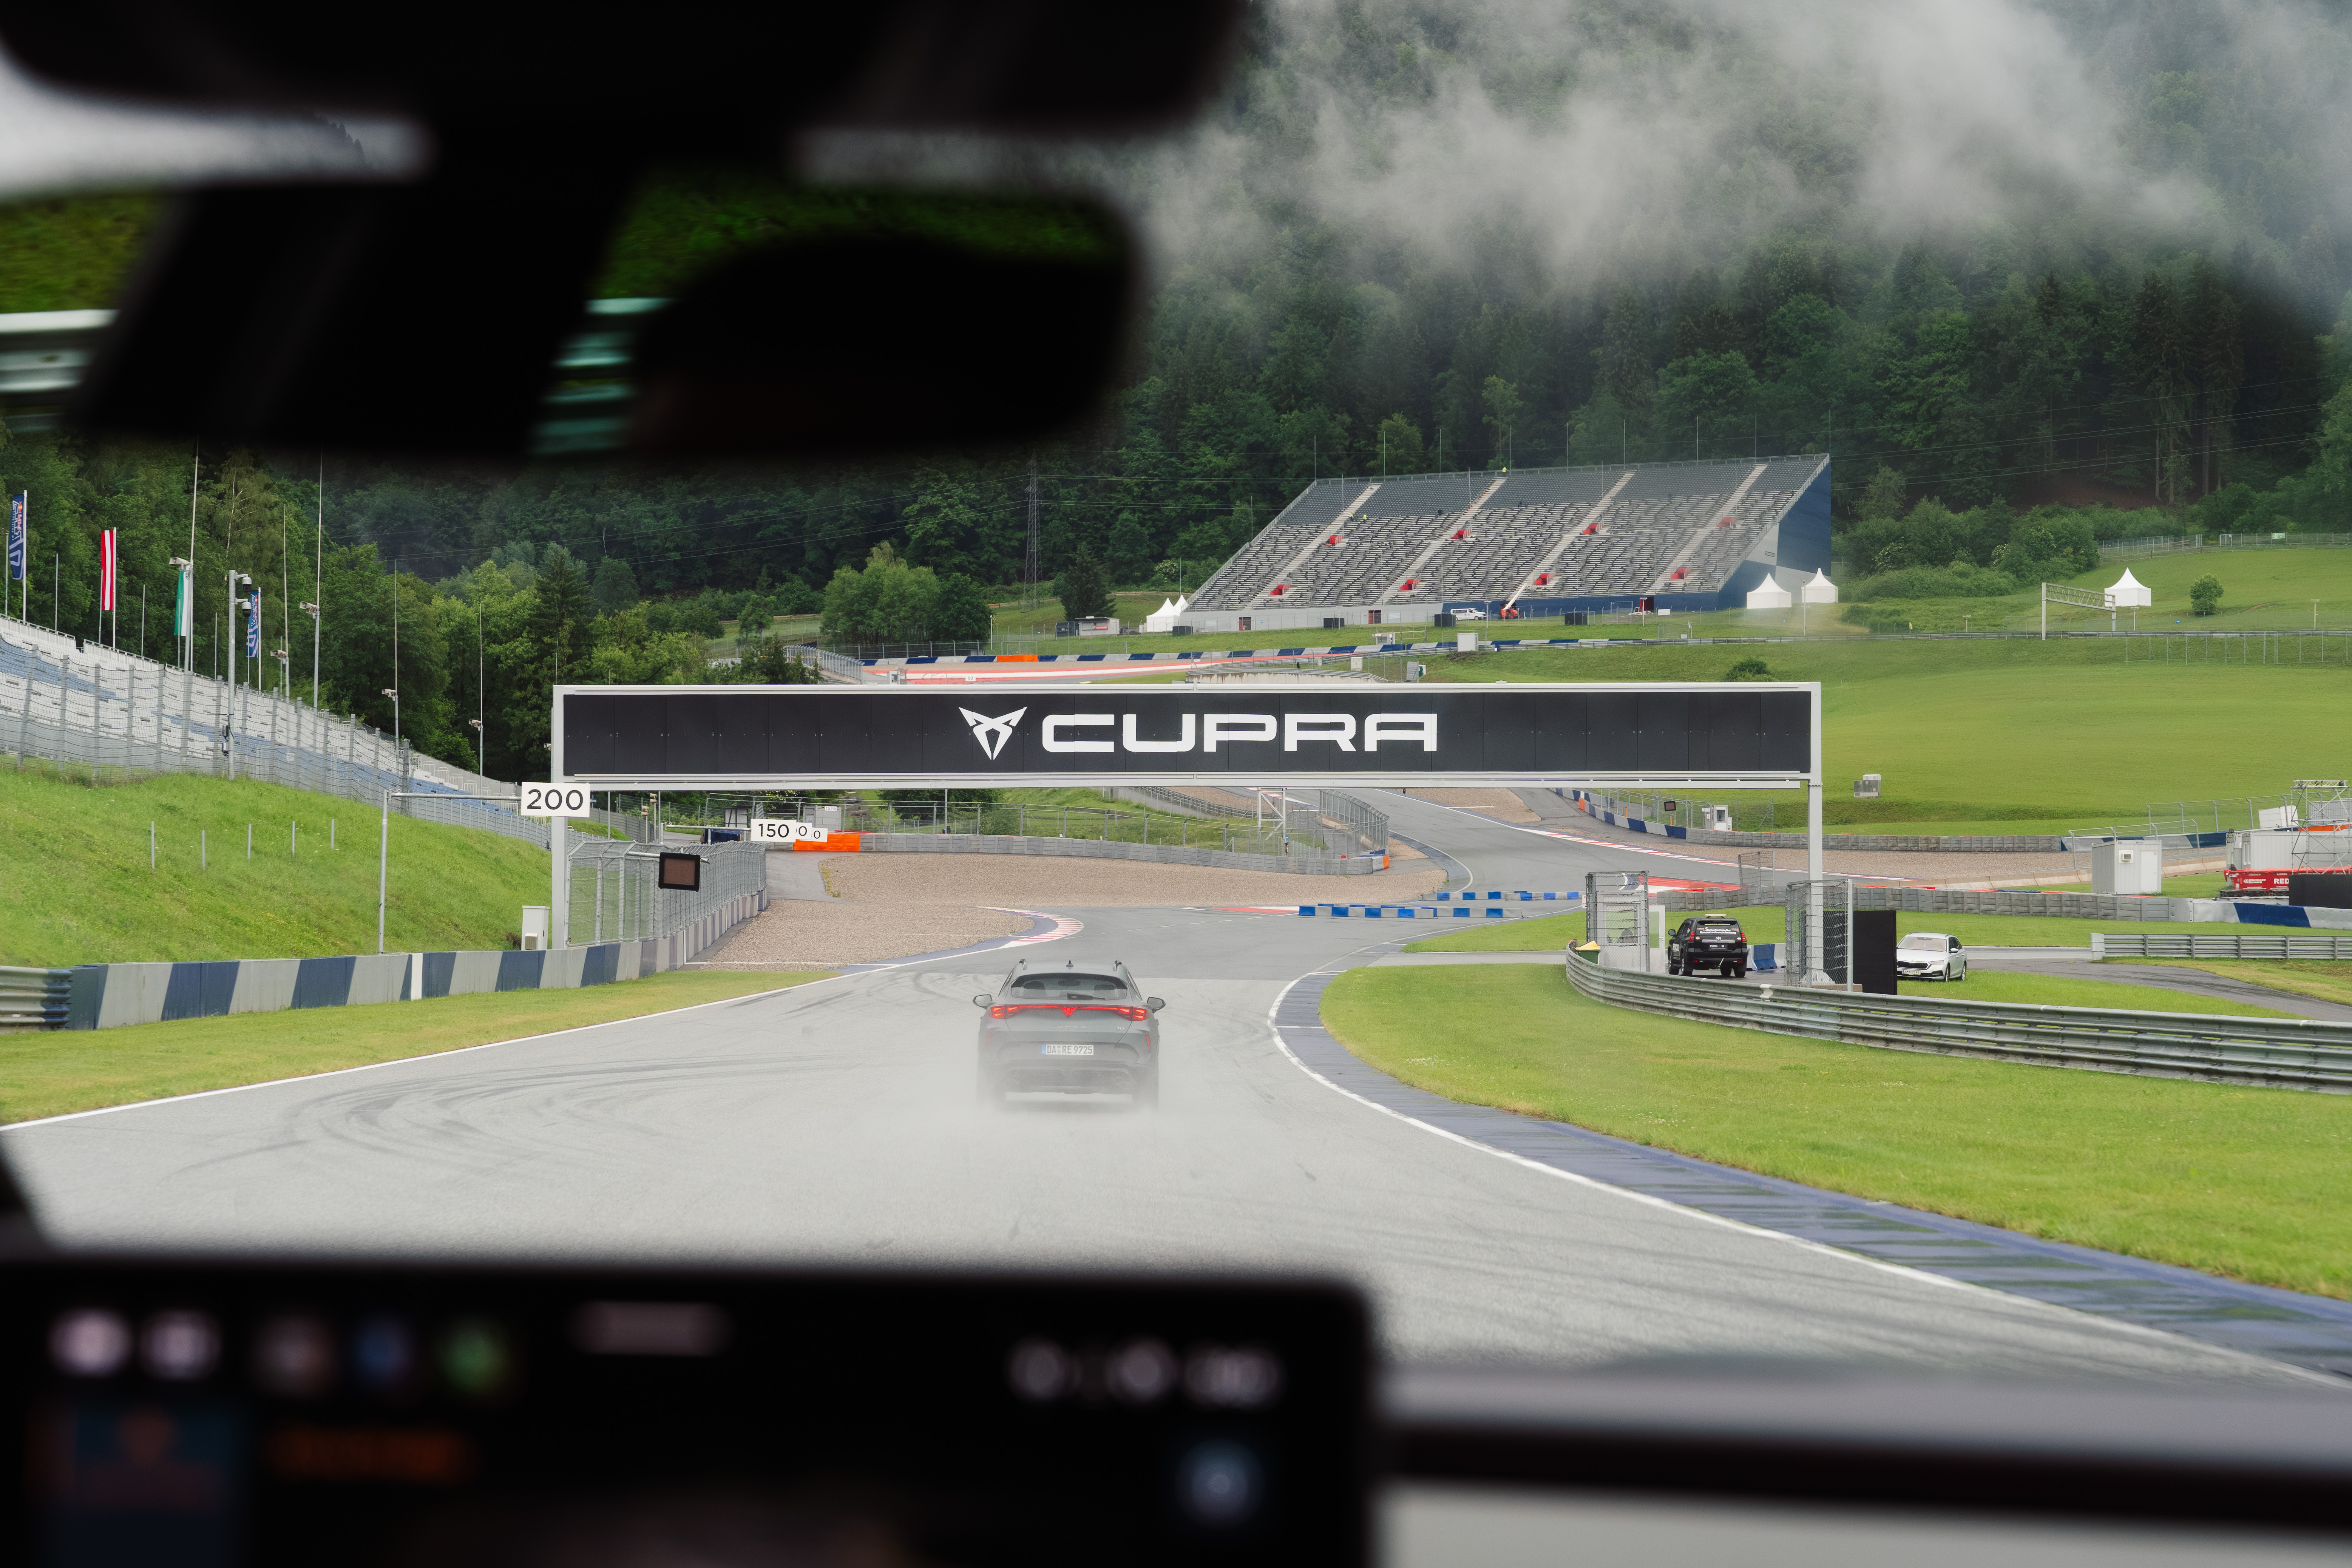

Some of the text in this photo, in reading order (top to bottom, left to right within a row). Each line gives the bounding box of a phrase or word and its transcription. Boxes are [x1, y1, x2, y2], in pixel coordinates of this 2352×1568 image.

[1042, 713, 1437, 752] CUPRA
[527, 789, 583, 810] 200
[758, 823, 789, 838] 150
[811, 830, 820, 839] 0
